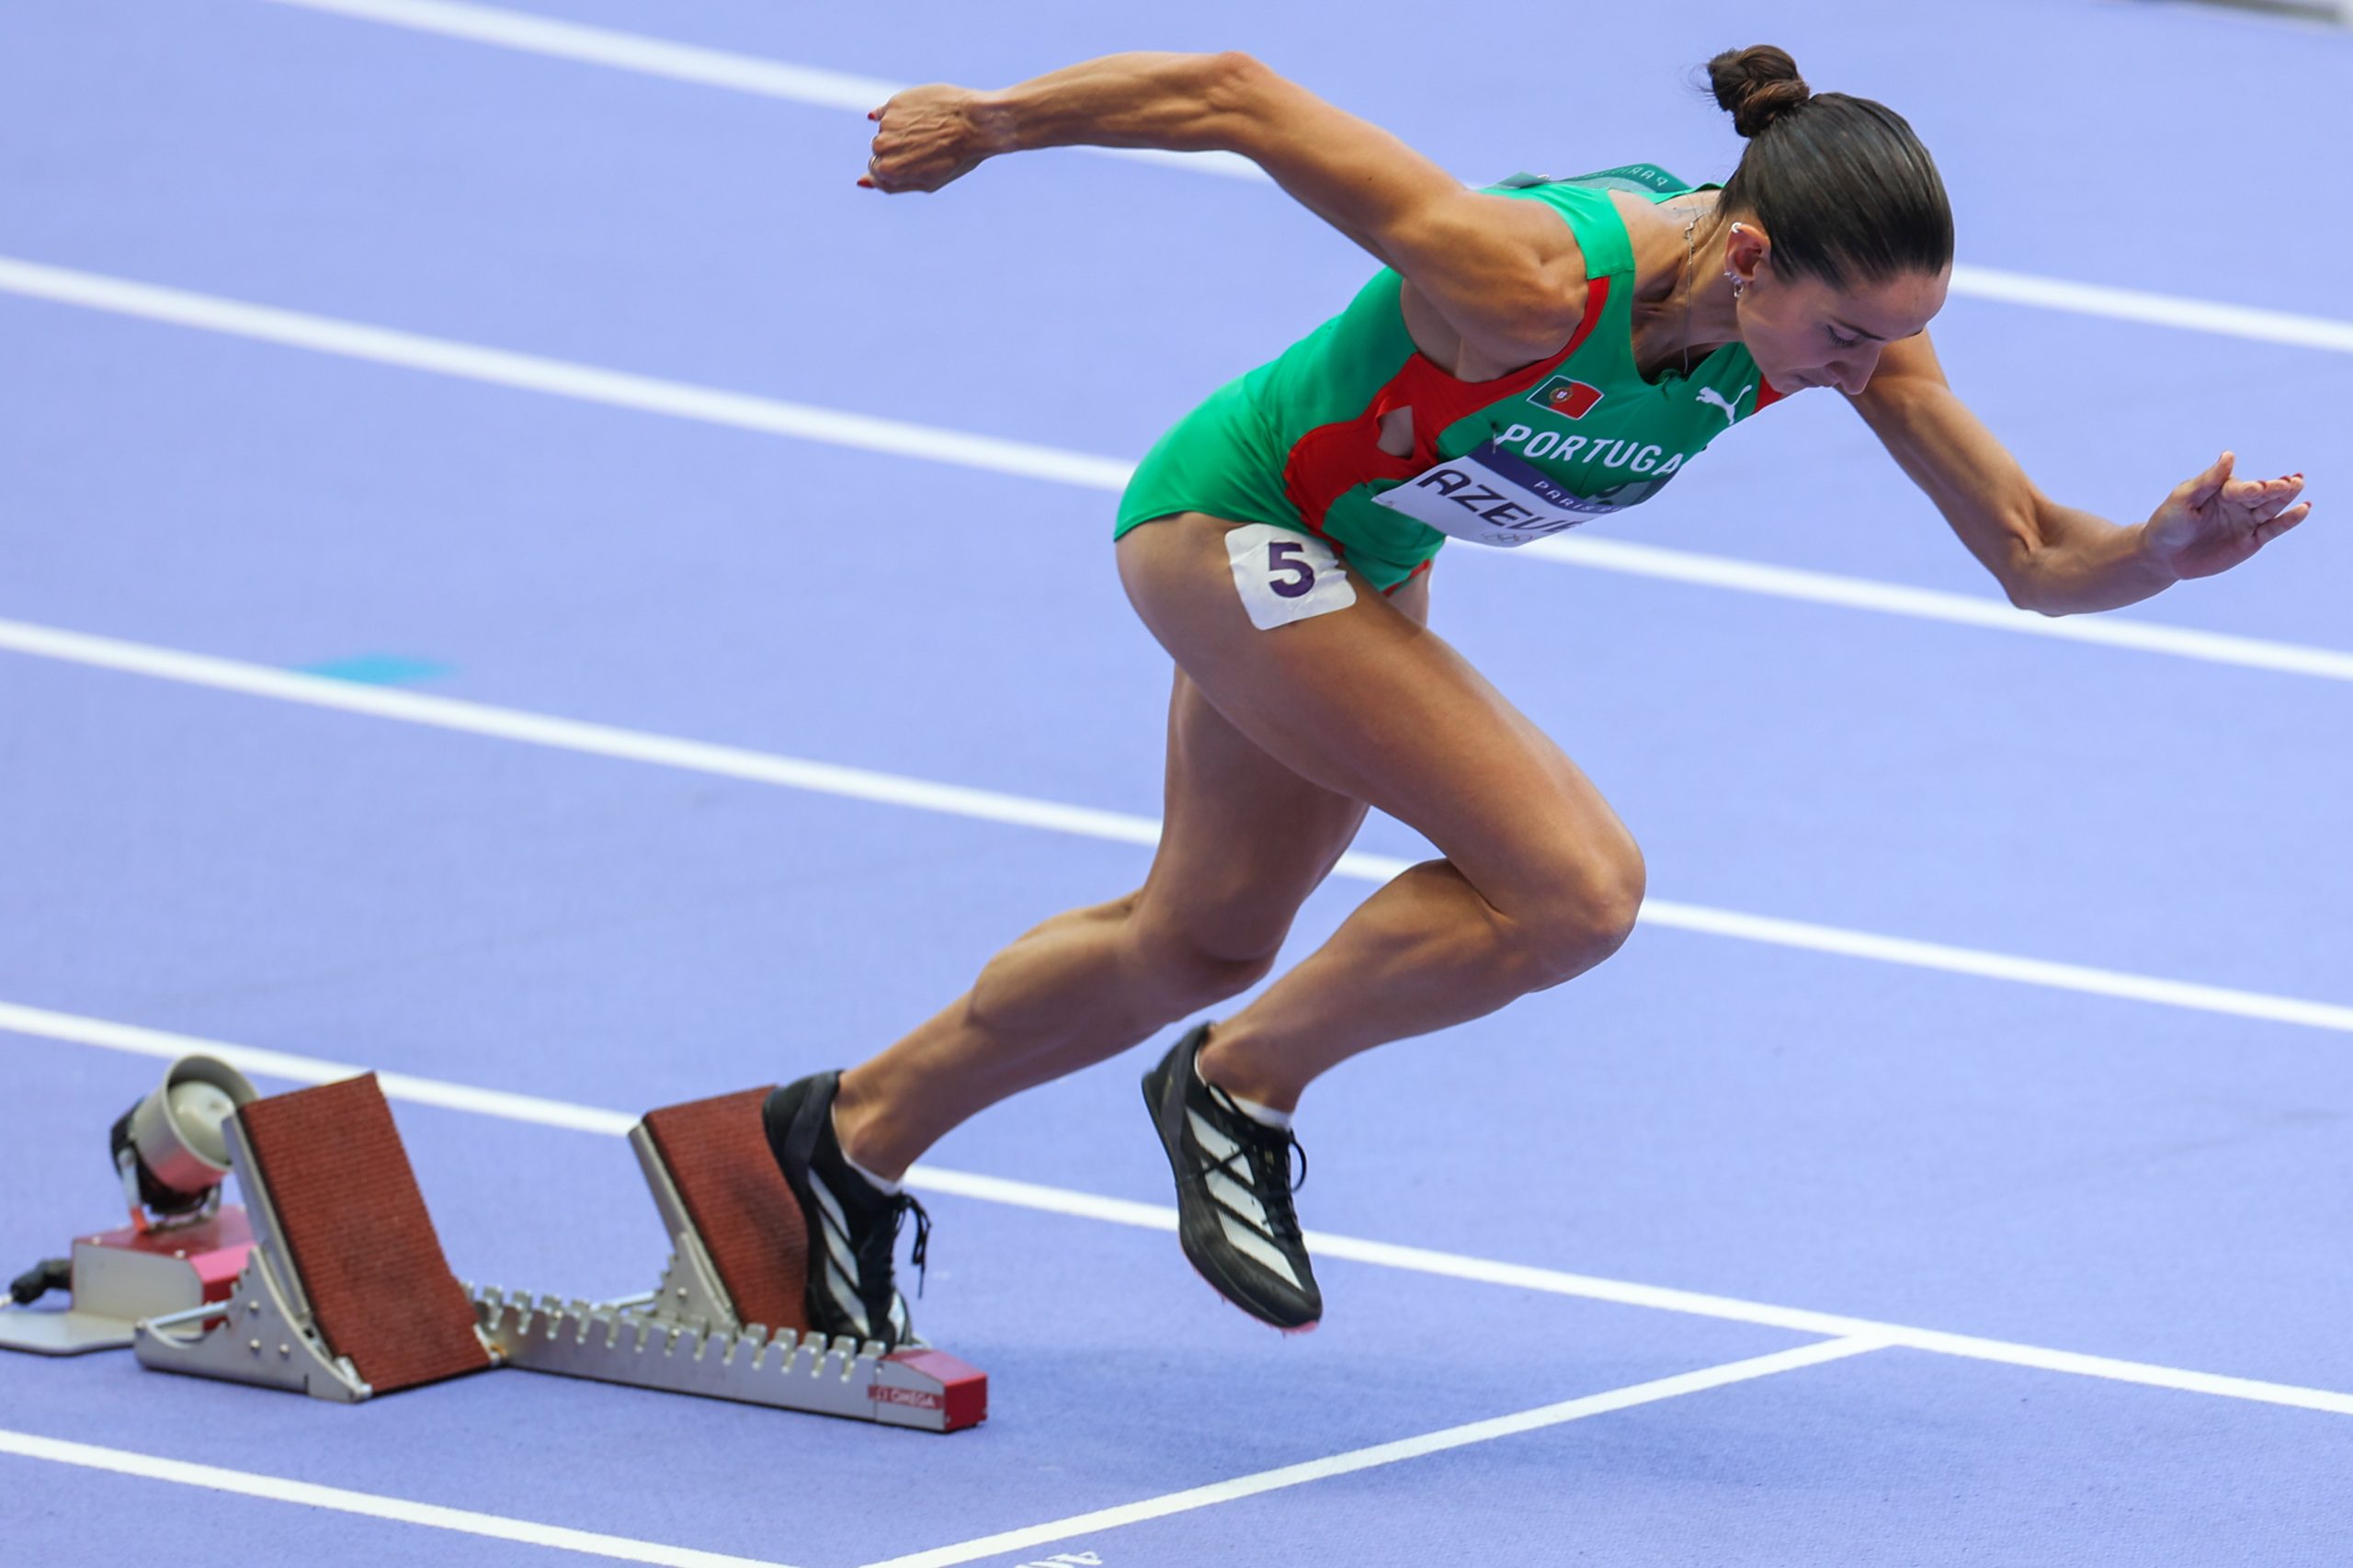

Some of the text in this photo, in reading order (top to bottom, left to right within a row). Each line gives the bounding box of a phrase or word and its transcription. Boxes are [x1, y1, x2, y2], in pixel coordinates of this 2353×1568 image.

[1495, 424, 1684, 476] PORTUGA
[1534, 481, 1595, 511] PARIS
[1268, 541, 1315, 598] 5
[891, 1389, 936, 1407] OMEGA
